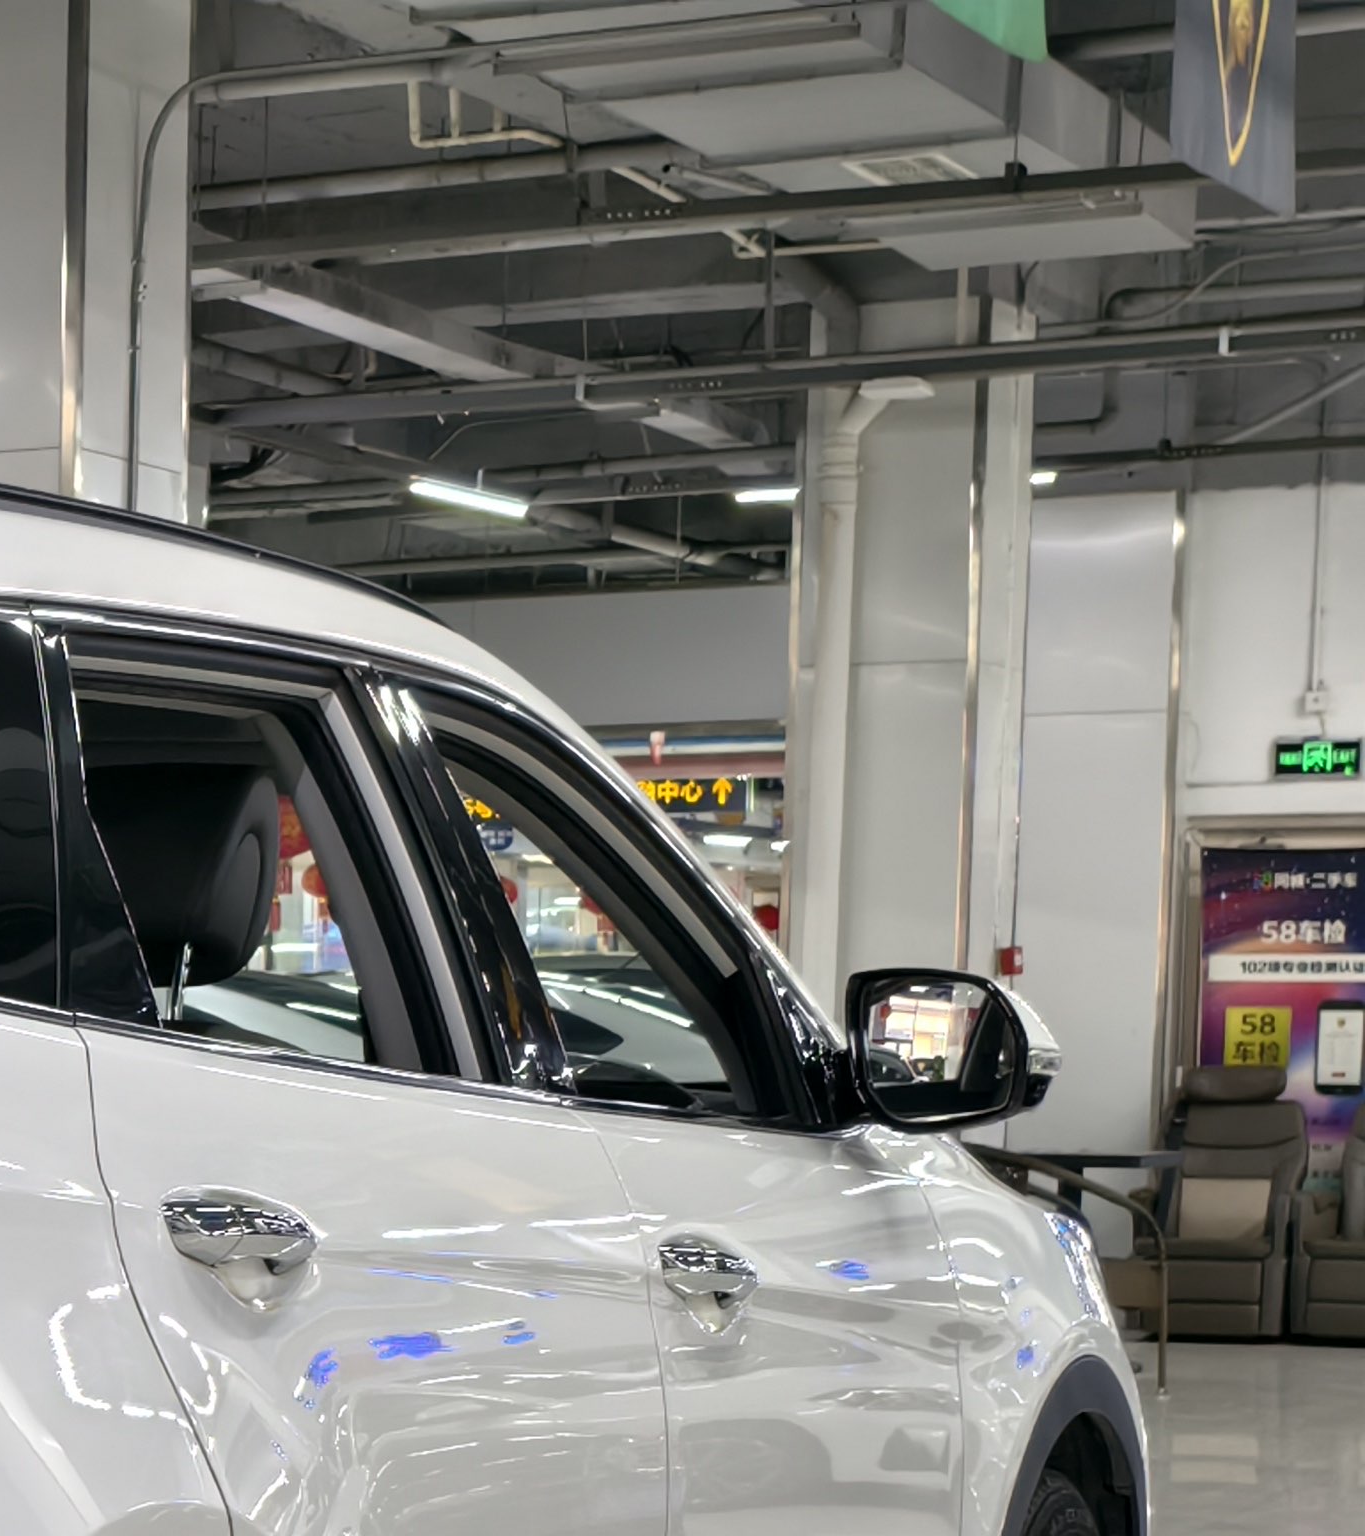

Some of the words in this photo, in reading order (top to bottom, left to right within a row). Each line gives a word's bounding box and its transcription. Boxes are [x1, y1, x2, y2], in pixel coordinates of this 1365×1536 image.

[1261, 919, 1346, 944] 58车检
[1240, 1013, 1276, 1036] 58
[1232, 1041, 1281, 1063] 车检
